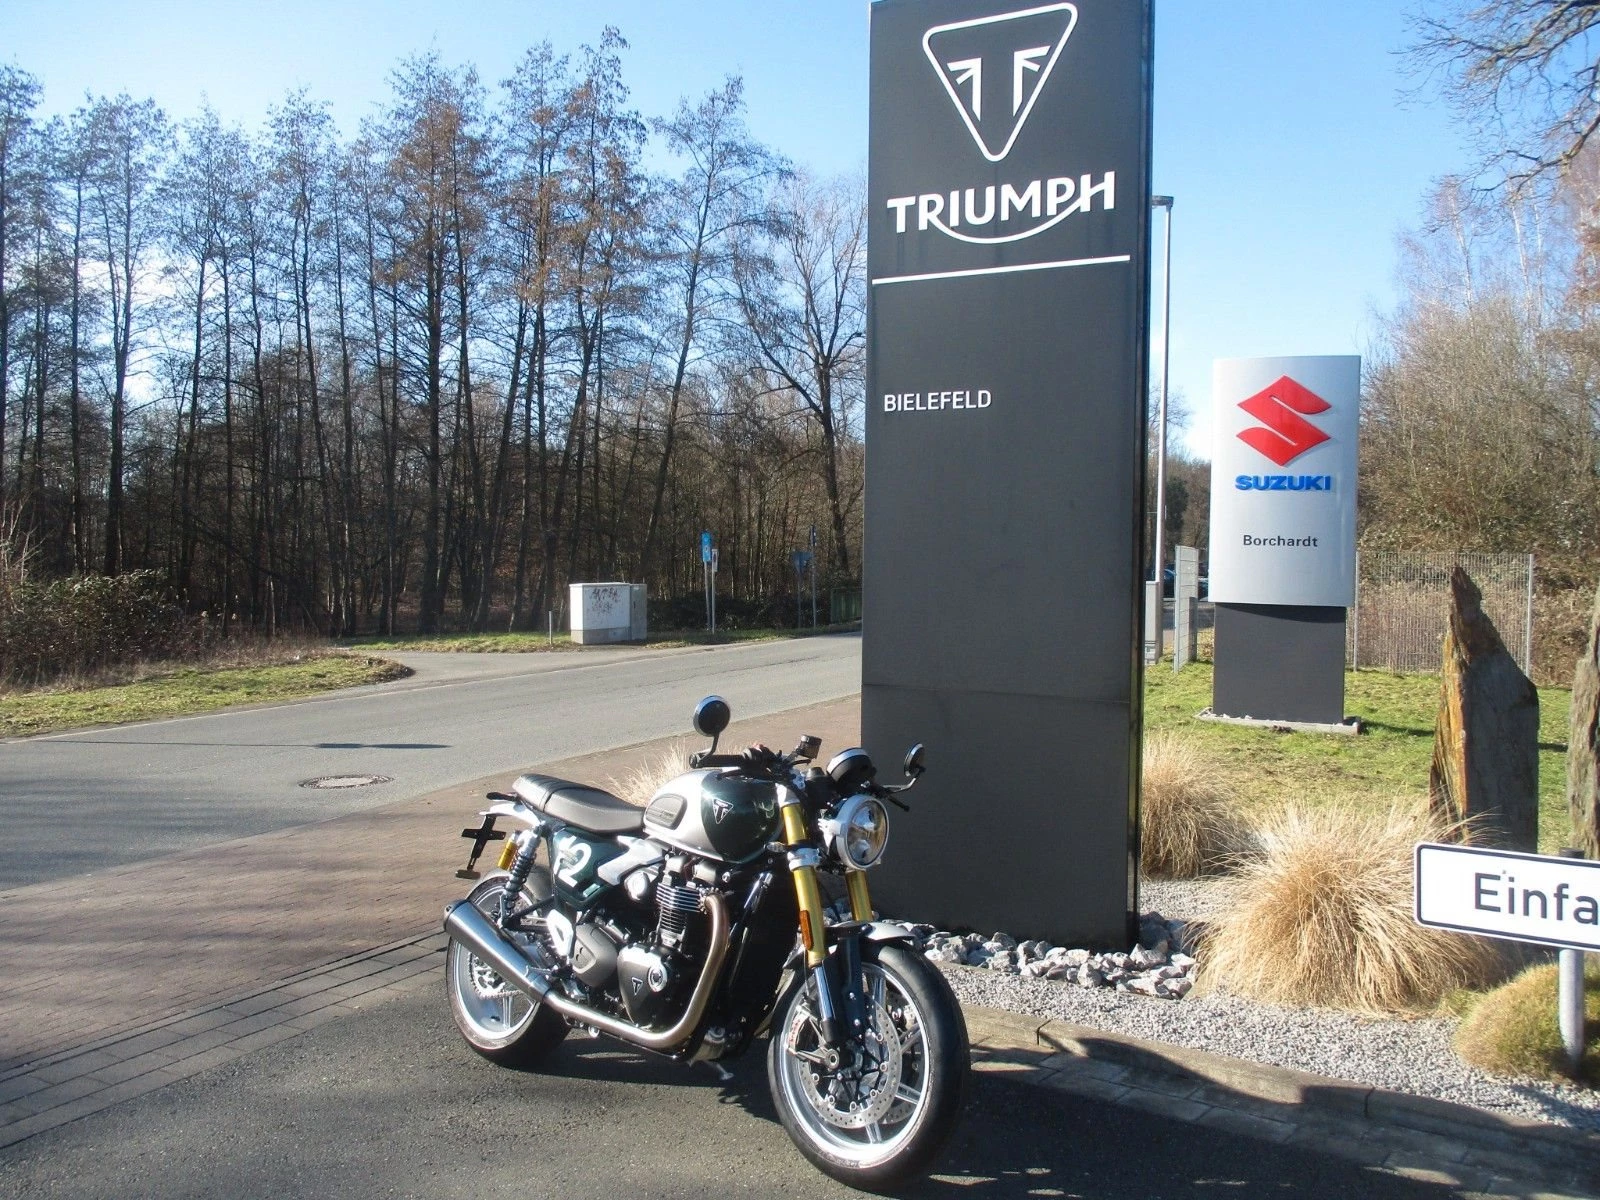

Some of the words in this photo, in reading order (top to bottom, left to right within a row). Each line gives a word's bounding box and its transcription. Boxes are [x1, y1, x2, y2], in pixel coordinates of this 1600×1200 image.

[886, 171, 1115, 244] TRIUMPH
[884, 390, 992, 412] BIELEFELD
[1235, 475, 1332, 491] SUZUKI
[1242, 534, 1319, 548] Borchardt
[1474, 872, 1599, 926] Einfa
